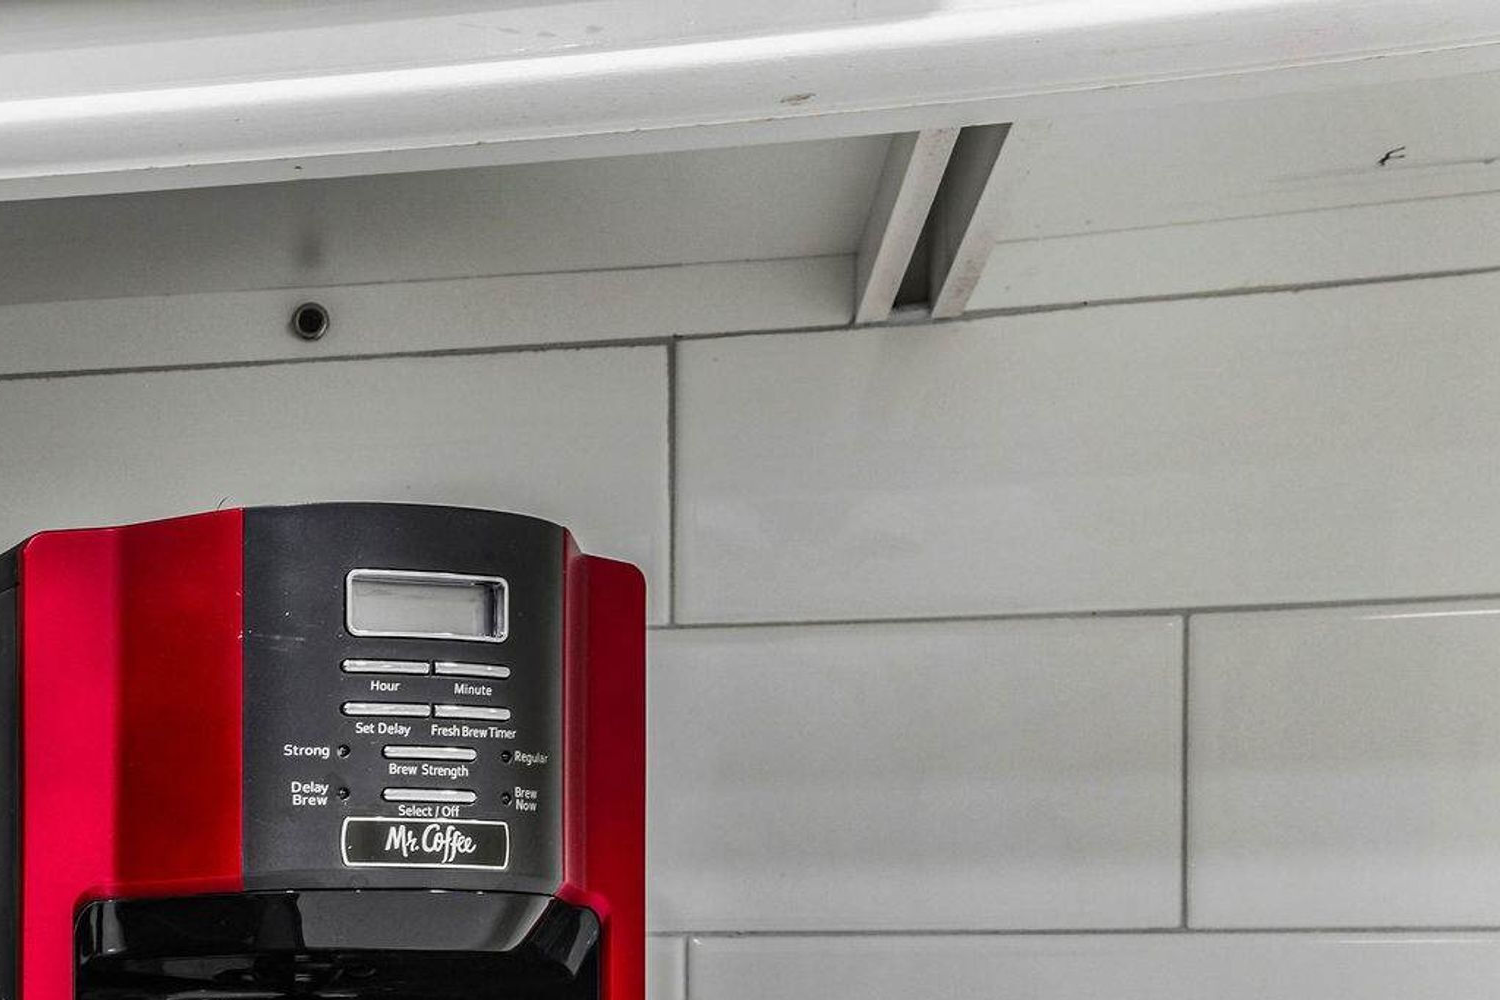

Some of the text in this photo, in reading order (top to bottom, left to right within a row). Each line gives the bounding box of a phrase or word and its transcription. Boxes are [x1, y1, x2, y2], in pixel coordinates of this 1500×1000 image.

[370, 680, 400, 692] Hour
[454, 683, 492, 696] Minute
[355, 722, 411, 737] Set Delay
[431, 724, 516, 739] Fresh Brew Timer
[283, 744, 330, 759] Strong
[514, 751, 548, 765] Regular
[389, 763, 469, 780] Brew Strength
[291, 781, 329, 796] Delay
[514, 787, 537, 799] Brew
[292, 794, 328, 806] Brew
[515, 799, 537, 811] Now
[398, 805, 460, 818] Select / Off
[384, 823, 477, 864] Mr. Coffee
